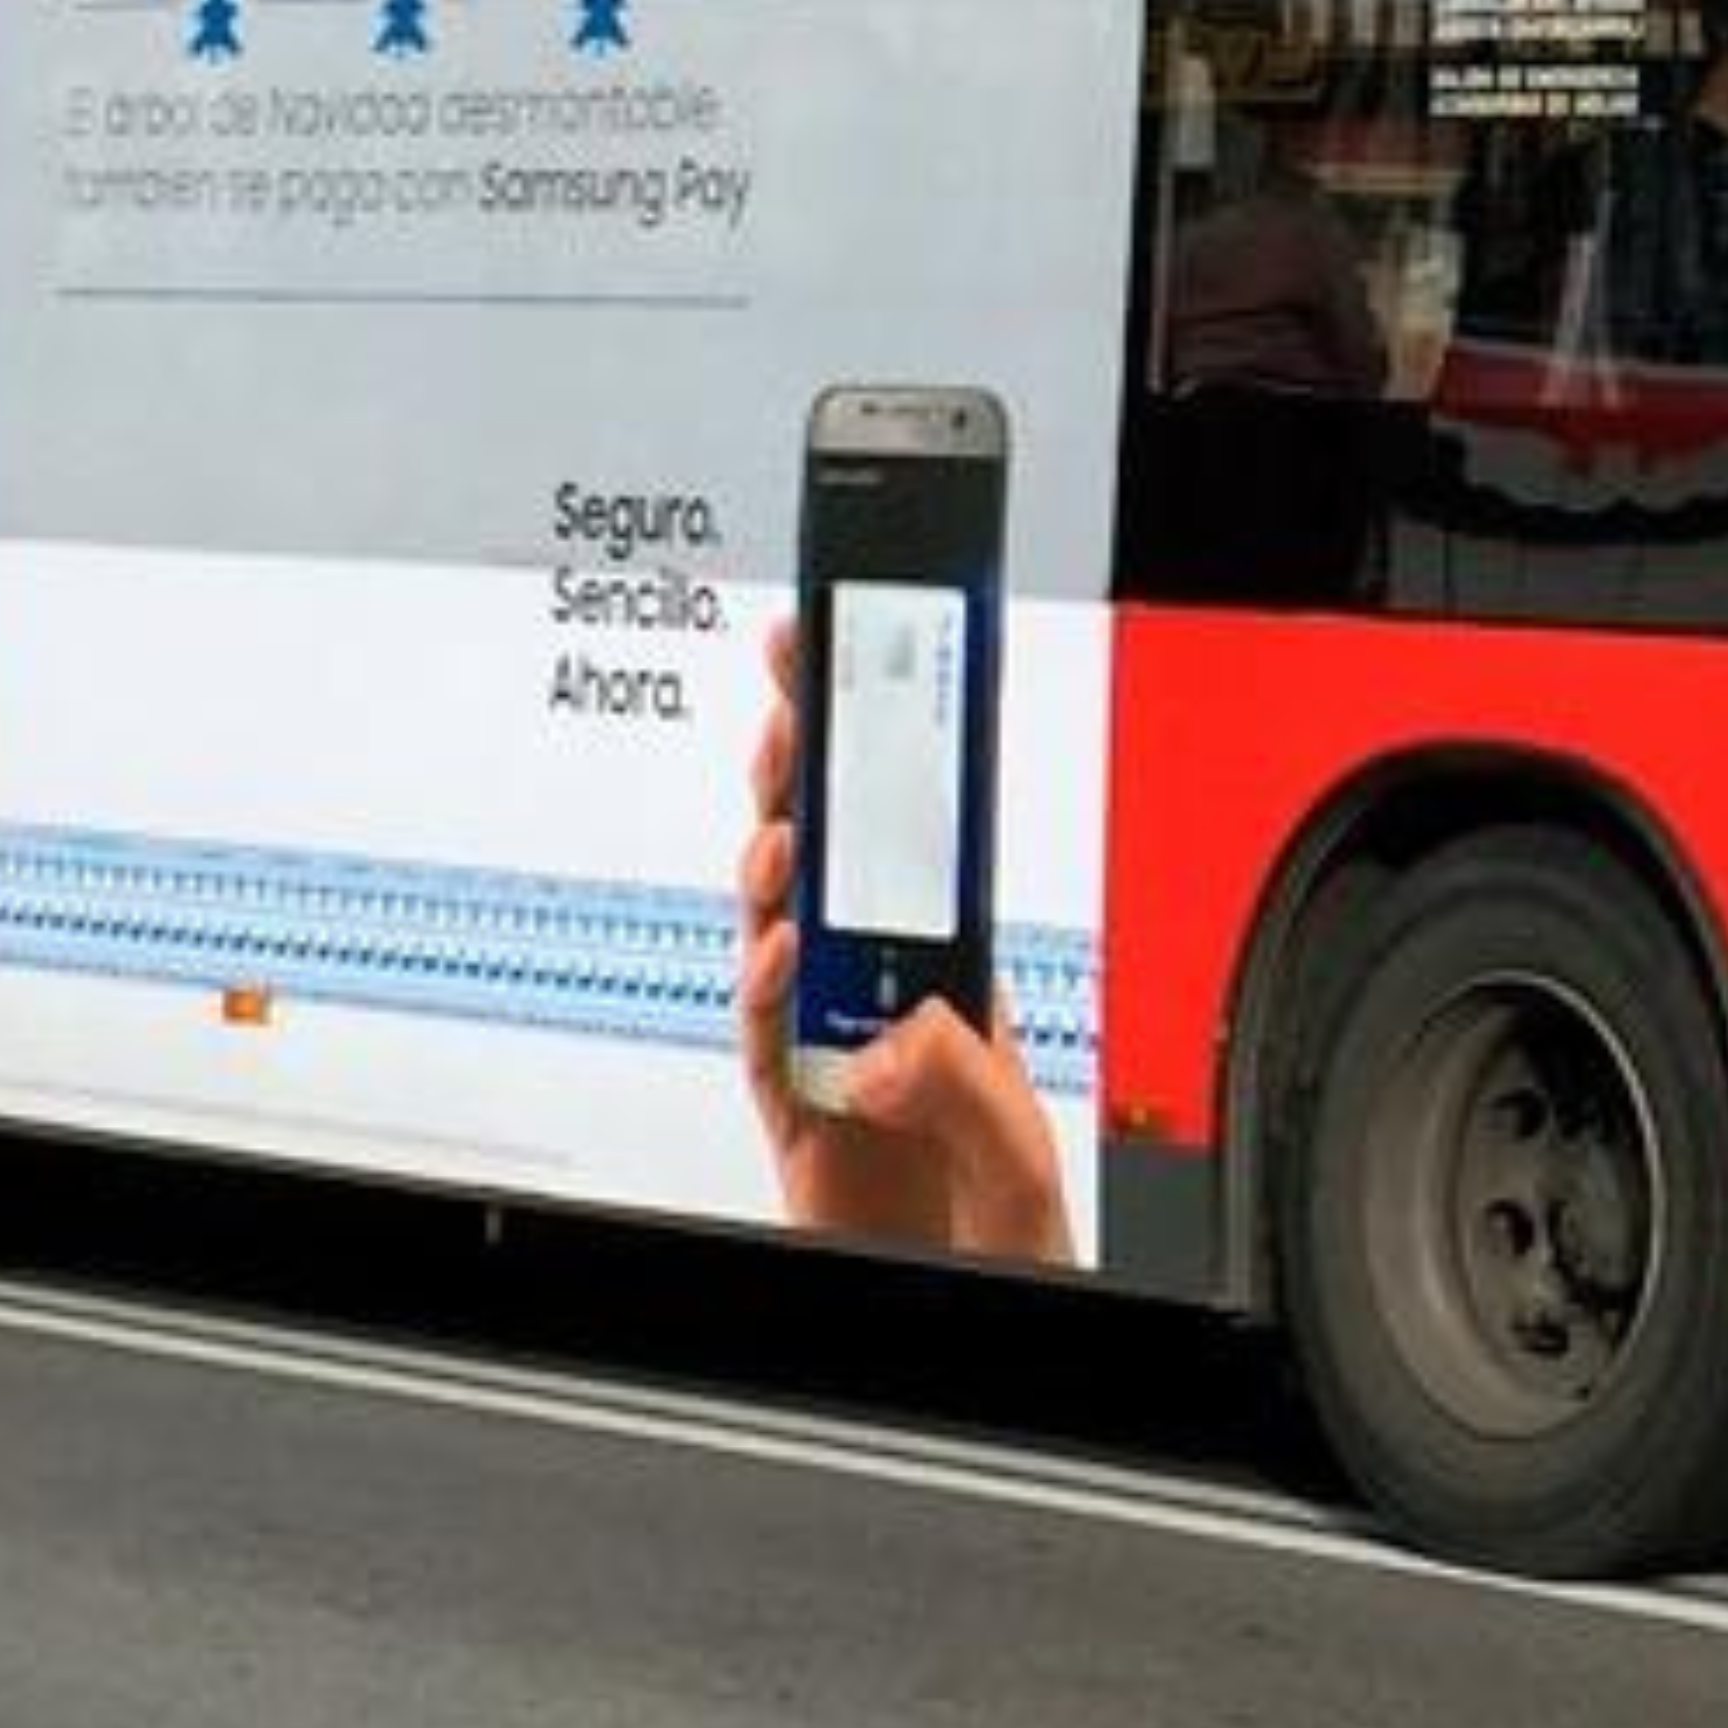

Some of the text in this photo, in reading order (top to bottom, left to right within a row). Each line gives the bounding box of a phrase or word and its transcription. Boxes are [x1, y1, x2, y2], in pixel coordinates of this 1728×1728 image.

[478, 159, 665, 228] Samsung
[677, 155, 752, 228] Pay
[554, 480, 723, 561] Seguro.
[551, 565, 731, 630] Sencillo.
[548, 653, 694, 718] Ahora.
